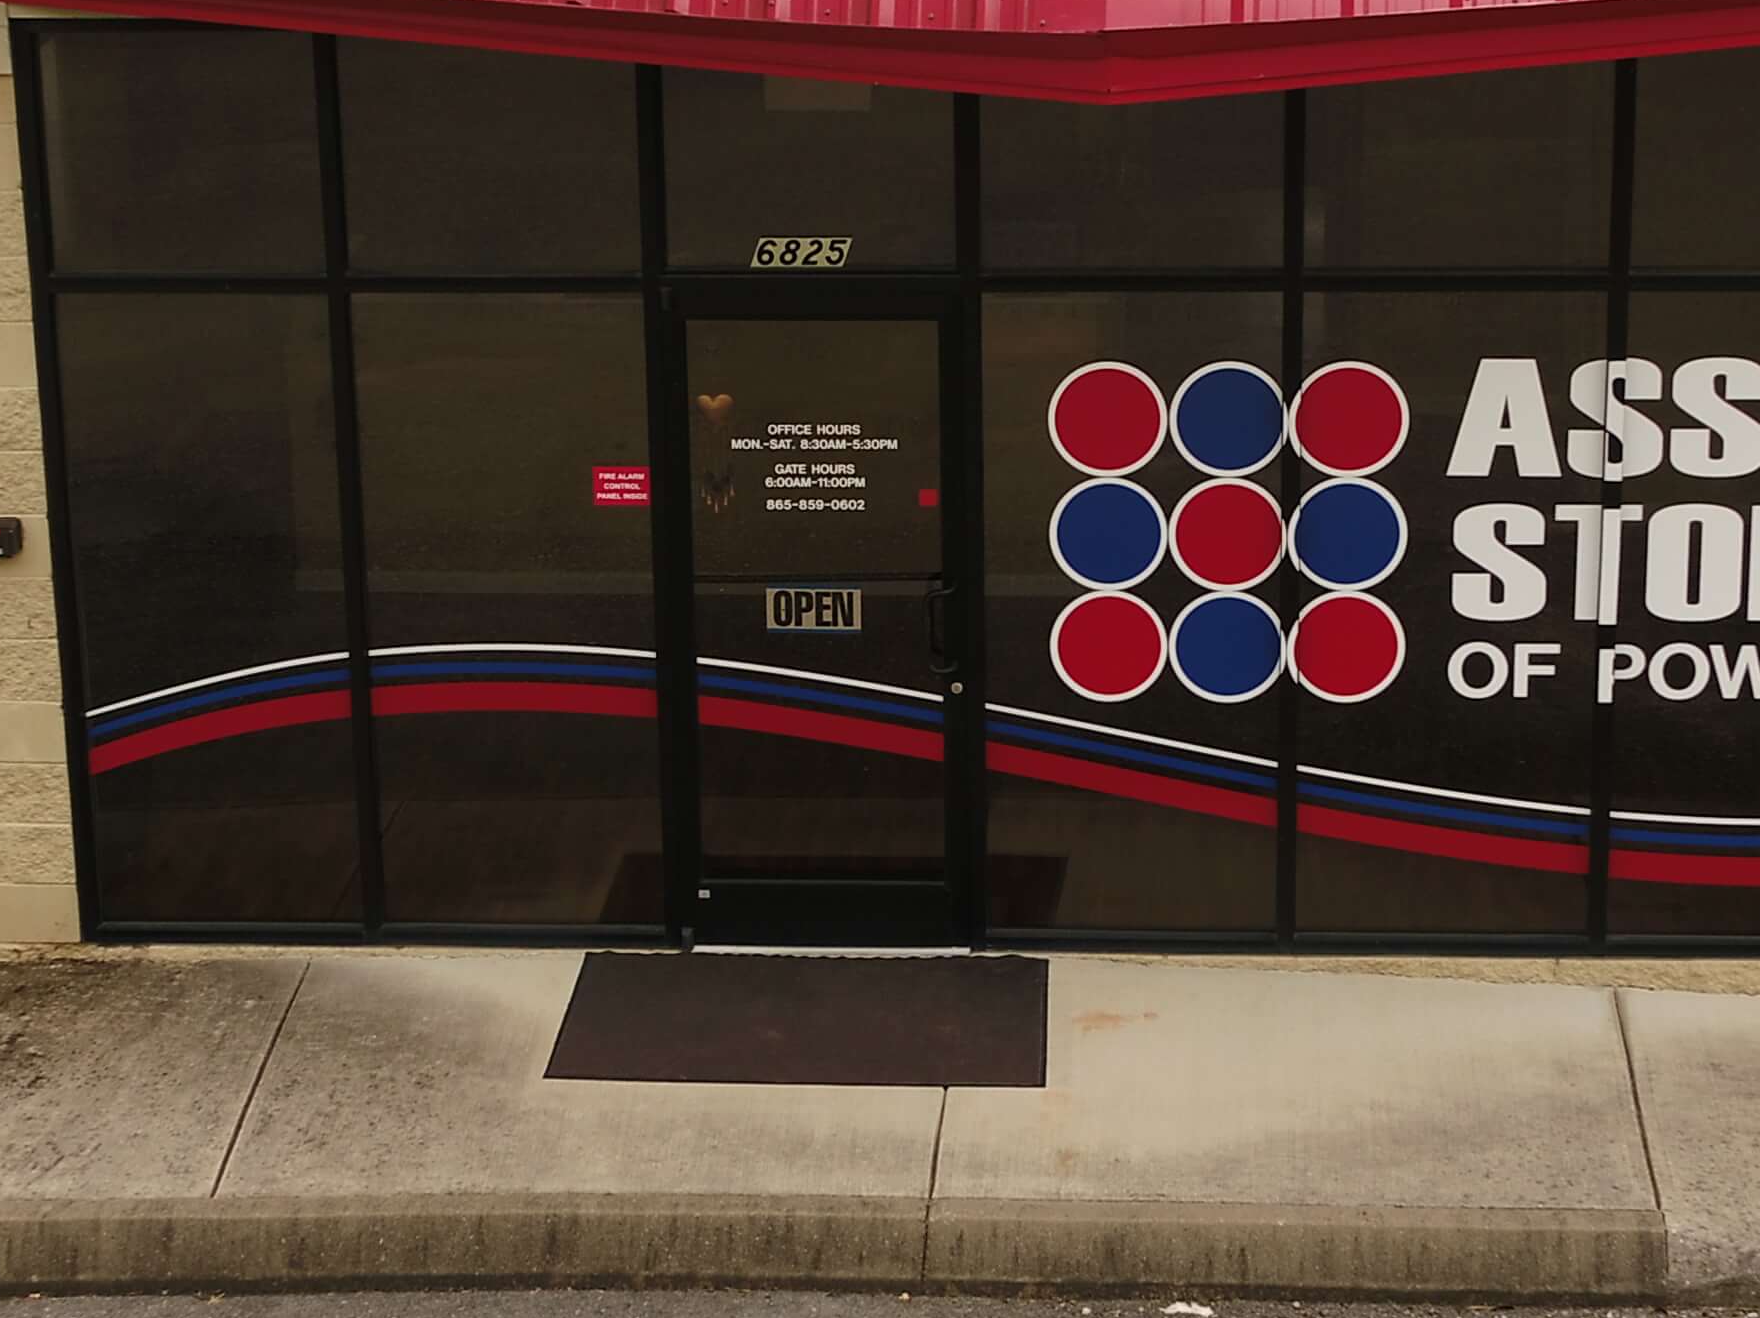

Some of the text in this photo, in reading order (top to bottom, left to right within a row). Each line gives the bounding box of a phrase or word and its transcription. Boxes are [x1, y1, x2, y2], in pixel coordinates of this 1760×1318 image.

[757, 239, 848, 266] 6825
[767, 424, 861, 436] OFFICE HOURS
[800, 438, 898, 450] 8:30AM-5:30PM
[774, 463, 856, 475] GATE HOURS
[603, 482, 641, 490] CONTROL
[765, 476, 866, 488] 6:00AM-11:00PM
[766, 499, 866, 511] 865-859-0602
[772, 591, 855, 627] OPEN
[1448, 642, 1561, 699] OF
